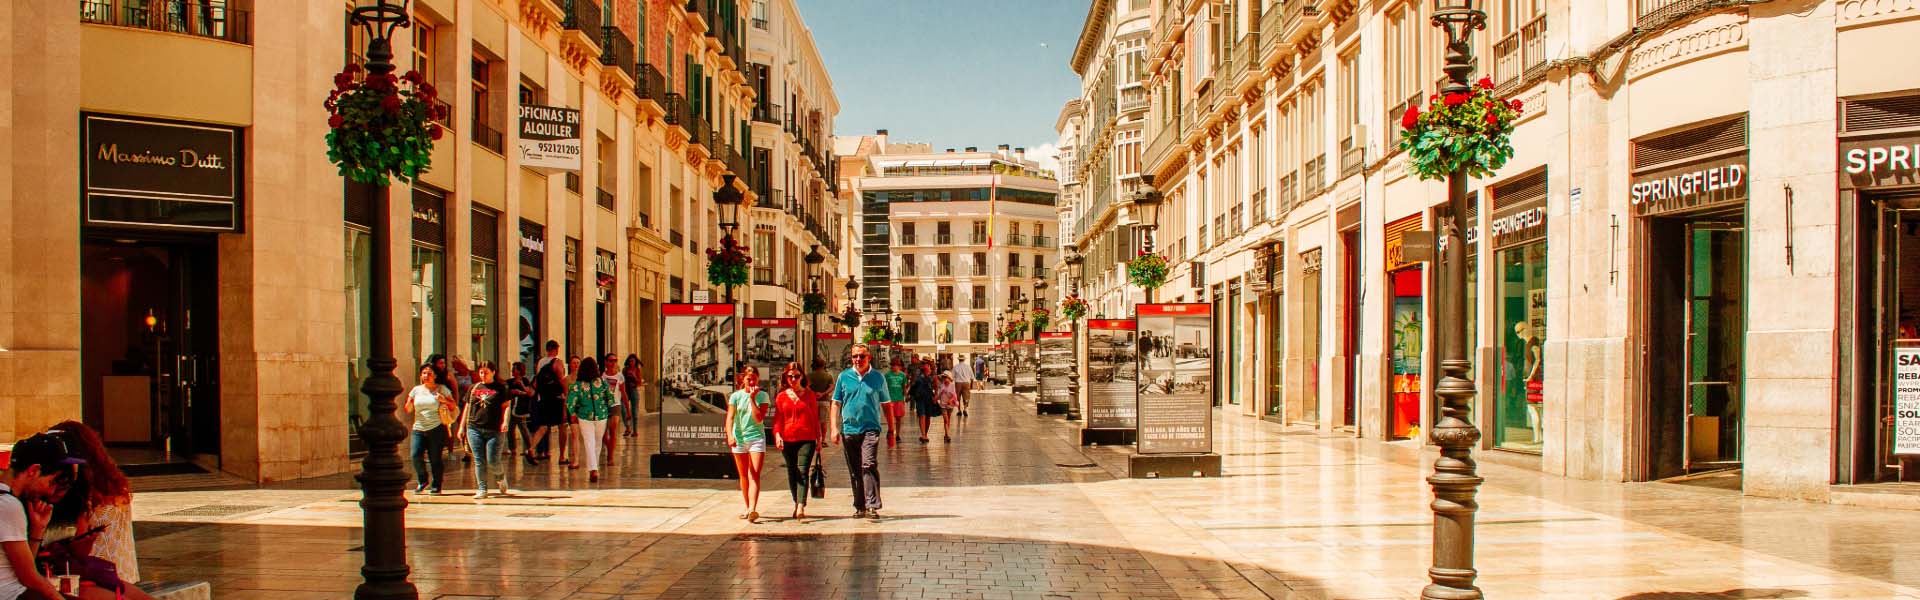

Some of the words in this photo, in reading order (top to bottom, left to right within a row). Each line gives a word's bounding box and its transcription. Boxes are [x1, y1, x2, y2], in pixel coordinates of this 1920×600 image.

[519, 106, 564, 122] OFICINAS
[566, 111, 579, 124] EN
[524, 121, 572, 138] ALQUILER
[98, 143, 176, 166] Massimo
[179, 150, 225, 169] Dutti
[538, 143, 580, 155] 952121205
[1846, 144, 1920, 174] SPRI
[1632, 164, 1742, 205] SPRINGFIELD
[1492, 207, 1542, 237] SPRINGFIELD
